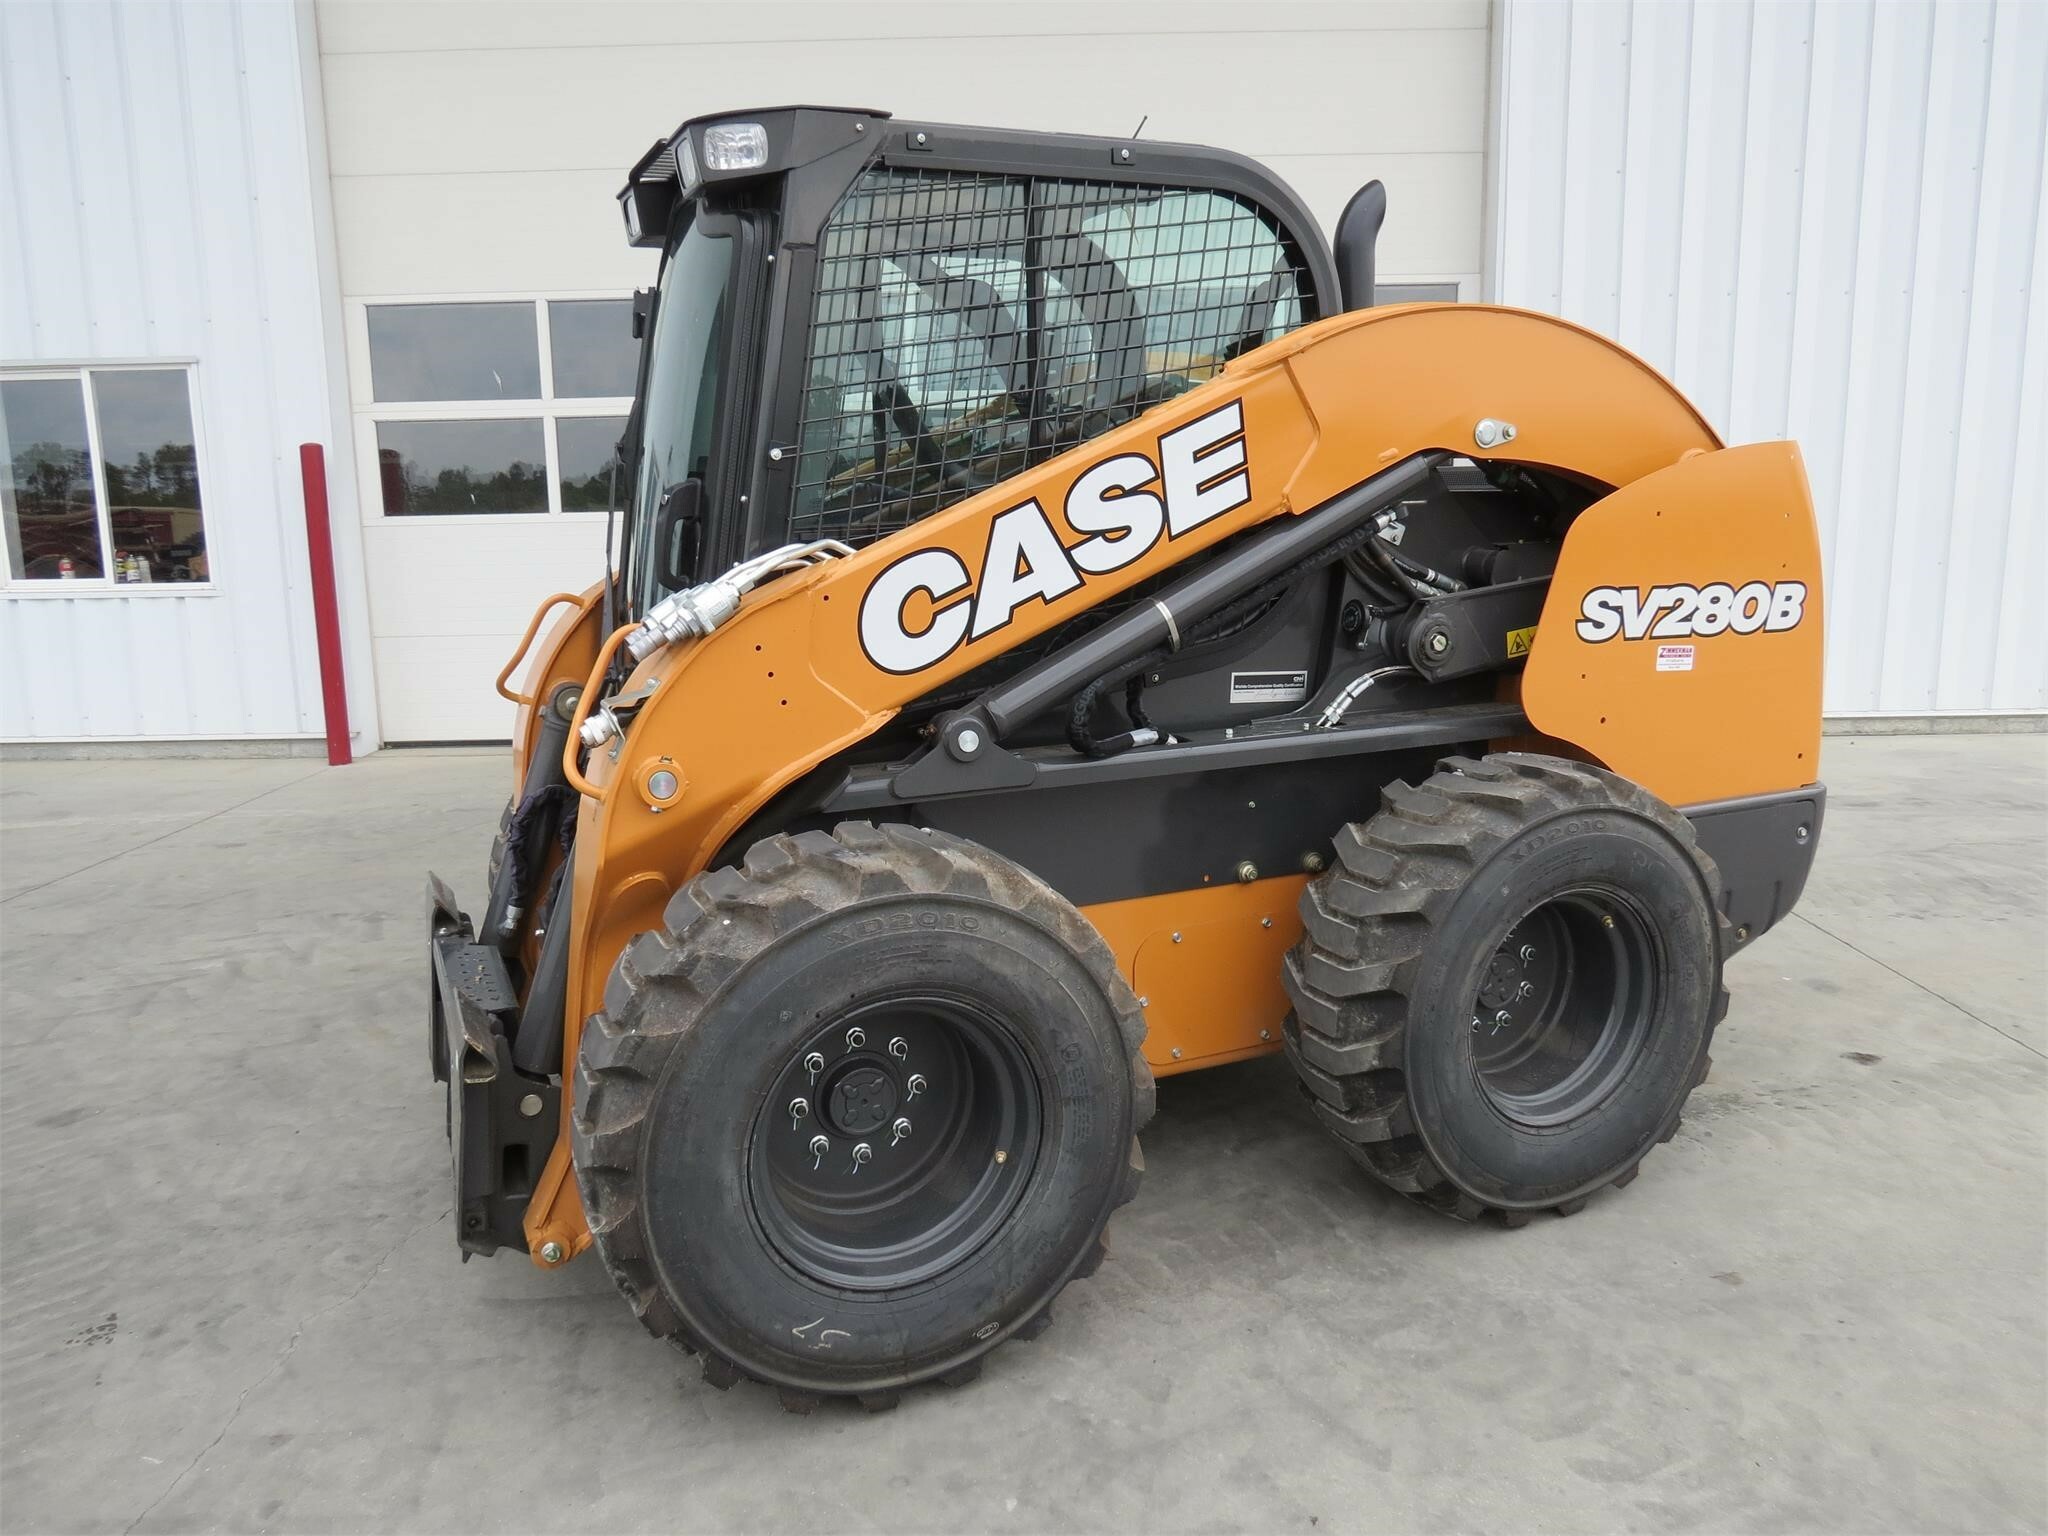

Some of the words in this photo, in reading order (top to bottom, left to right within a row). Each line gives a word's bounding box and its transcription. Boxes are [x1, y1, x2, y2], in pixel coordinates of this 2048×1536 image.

[858, 397, 1252, 676] CASE
[1575, 580, 1807, 644] SV280B
[1506, 818, 1609, 864] XD2010
[824, 911, 981, 946] XD2010
